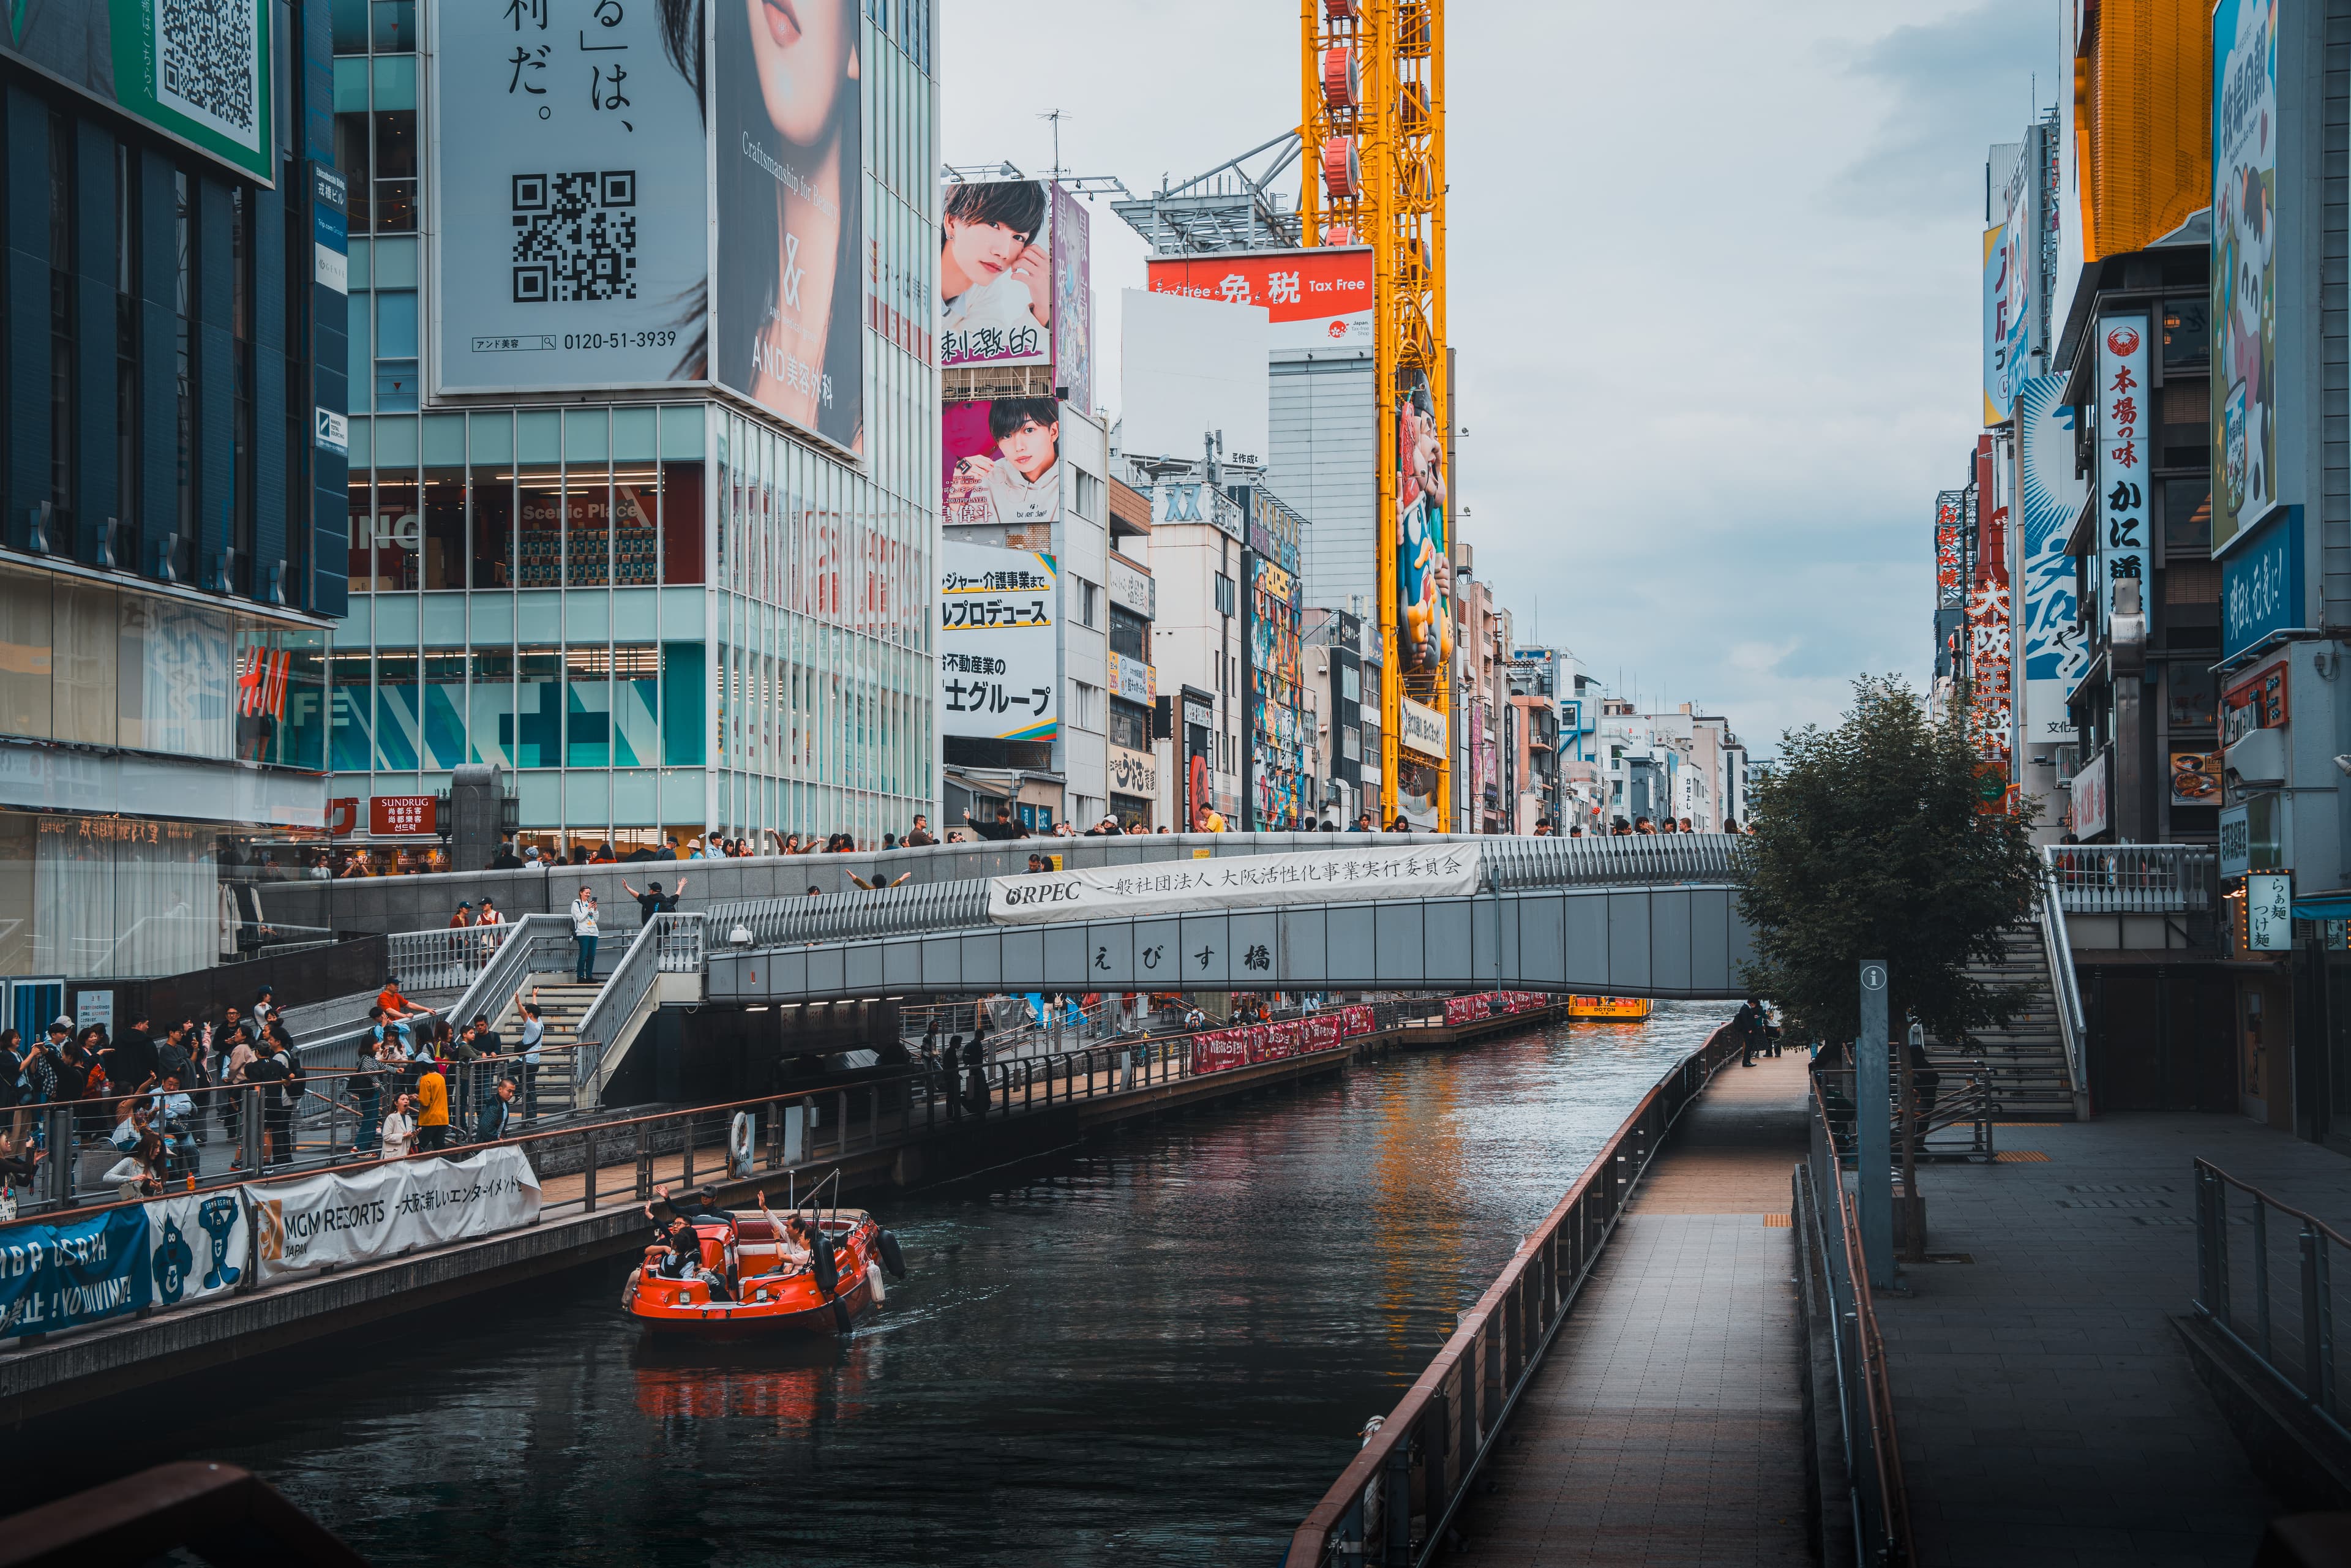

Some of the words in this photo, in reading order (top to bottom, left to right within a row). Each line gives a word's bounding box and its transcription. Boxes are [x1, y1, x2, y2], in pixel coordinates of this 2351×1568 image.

[2222, 19, 2266, 158] 牧場の朝
[743, 130, 798, 196] Craftsmanship
[800, 178, 811, 200] for
[813, 184, 839, 225] Beauty
[318, 182, 344, 206] 戎橋ビル
[318, 218, 333, 231] Trip.com
[325, 263, 345, 279] GENIE
[1183, 286, 1210, 298] Free
[1309, 279, 1332, 293] Tax
[1337, 278, 1365, 291] Free
[769, 306, 781, 321] AND
[476, 339, 520, 350] アンド美容
[564, 330, 677, 350] 0120-51-3939
[942, 324, 1038, 361] 刺激的
[752, 335, 833, 410] AND美容外科
[2109, 365, 2139, 469] 本場の味
[523, 504, 583, 520] Scenic
[588, 503, 637, 519] Place
[1938, 503, 1961, 589] お好み焼
[2107, 479, 2142, 612] かに道
[942, 571, 1045, 591] ジャー・介護事業まで
[236, 644, 291, 723] H&M
[942, 678, 1051, 717] 士グループ
[2046, 721, 2079, 734] 文化
[381, 798, 429, 807] SUNDRUG
[388, 815, 422, 823] 尚都樂客
[394, 823, 416, 832] 선드럭
[1096, 870, 1213, 895] 一般社団法人
[1220, 855, 1462, 888] 大阪活性化事業実行委員会
[2271, 878, 2286, 920] らぁ麺
[2254, 905, 2270, 947] つけ麺
[1093, 943, 1270, 972] えびす橋
[284, 1212, 322, 1240] MGM
[324, 1199, 385, 1232] RESORTS
[285, 1242, 307, 1258] JAPAN
[82, 1274, 133, 1315] DIVING!
